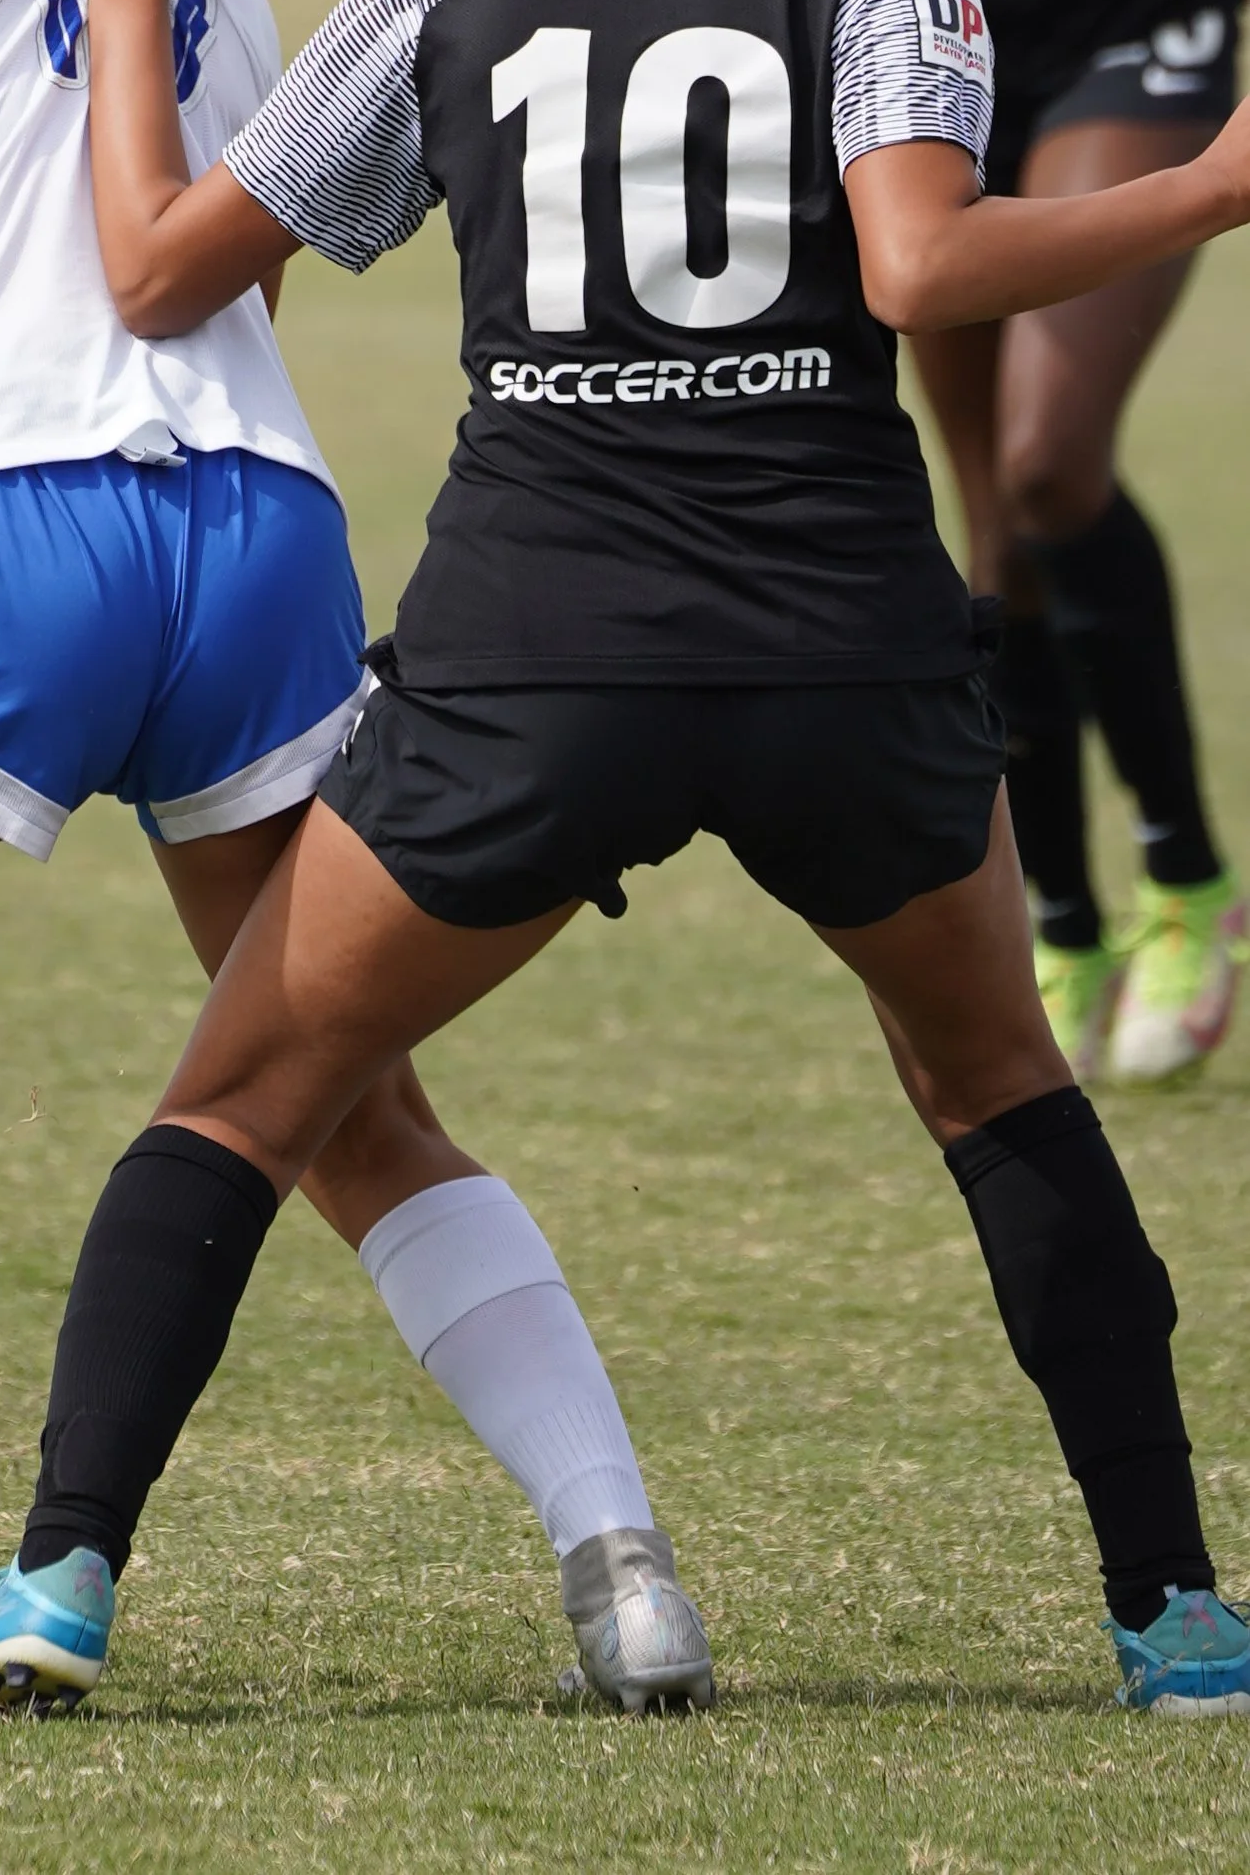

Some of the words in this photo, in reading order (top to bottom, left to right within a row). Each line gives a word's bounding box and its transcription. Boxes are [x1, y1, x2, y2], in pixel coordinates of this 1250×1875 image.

[933, 43, 963, 62] PLAYER
[491, 27, 792, 332] 10
[490, 347, 831, 404] SOCCER.COM
